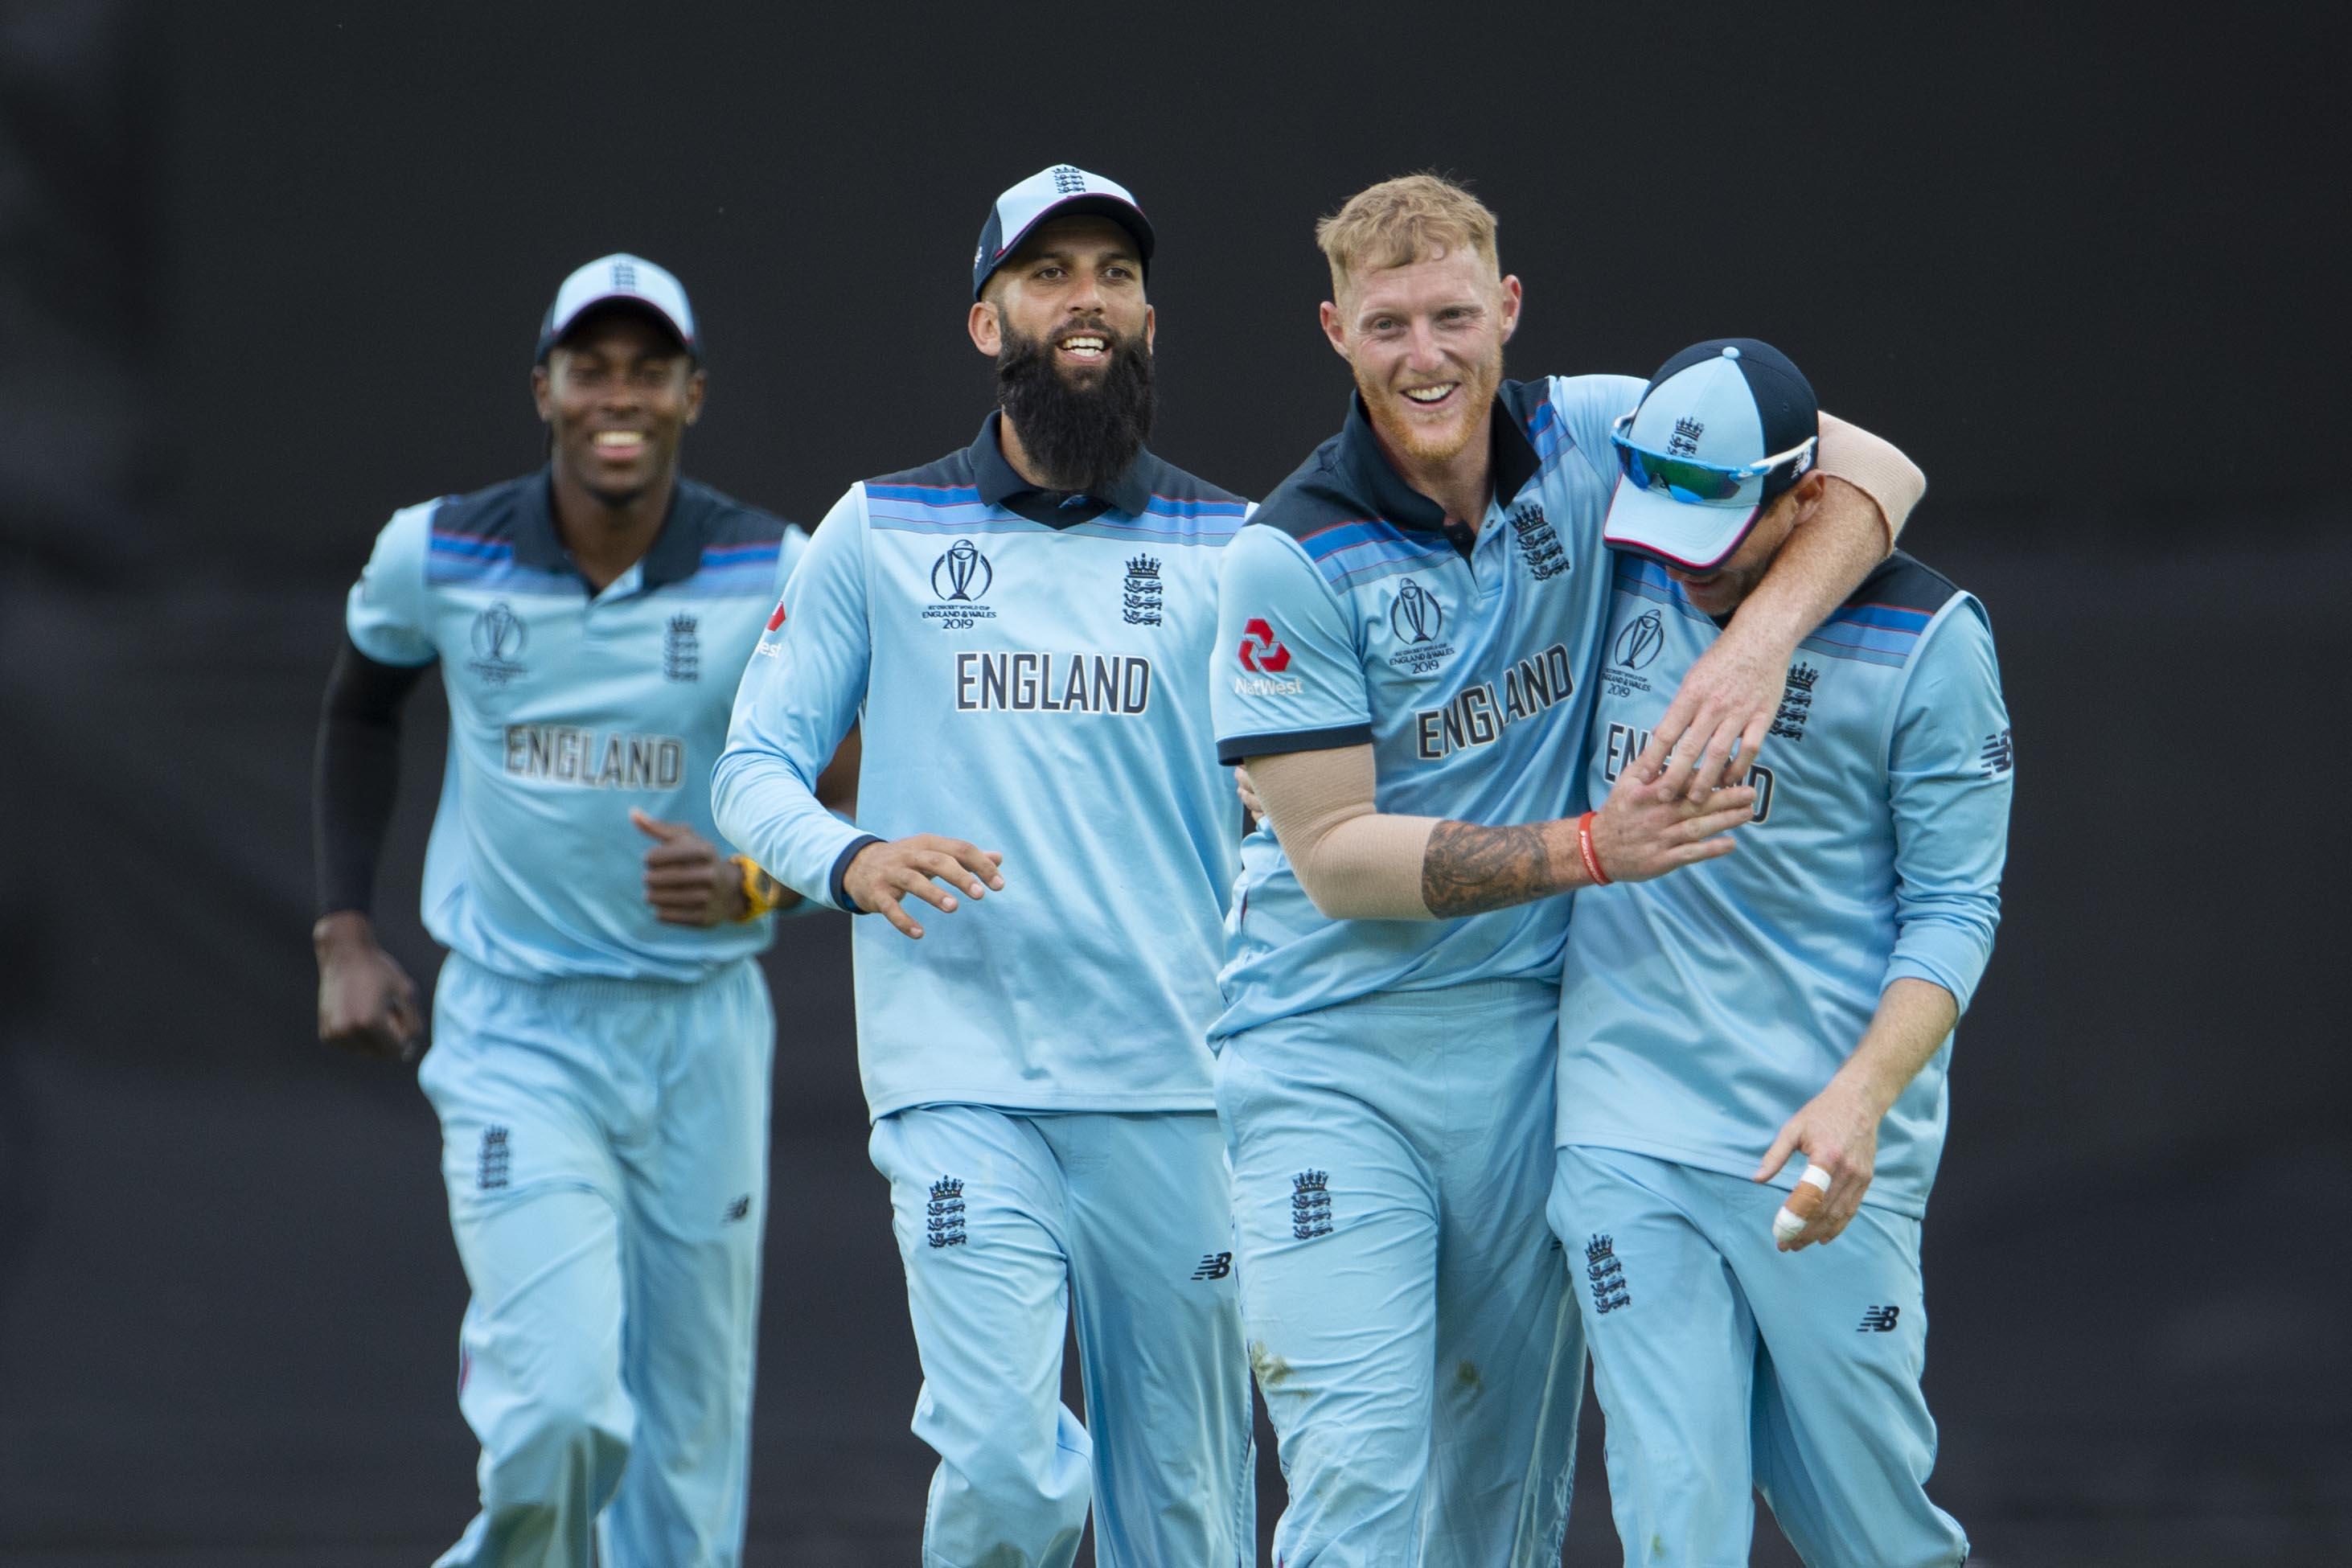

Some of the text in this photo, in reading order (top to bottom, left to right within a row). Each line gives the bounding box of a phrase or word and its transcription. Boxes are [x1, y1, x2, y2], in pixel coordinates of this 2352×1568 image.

[942, 618, 974, 630] 2019
[1389, 653, 1425, 666] ENGLAND
[1411, 659, 1439, 674] 2019
[955, 651, 1151, 715] ENGLAND
[1234, 675, 1304, 696] NatWest
[1607, 683, 1631, 697] 2019
[1415, 643, 1574, 760] ENGLAND
[503, 723, 686, 791] ENGLAND
